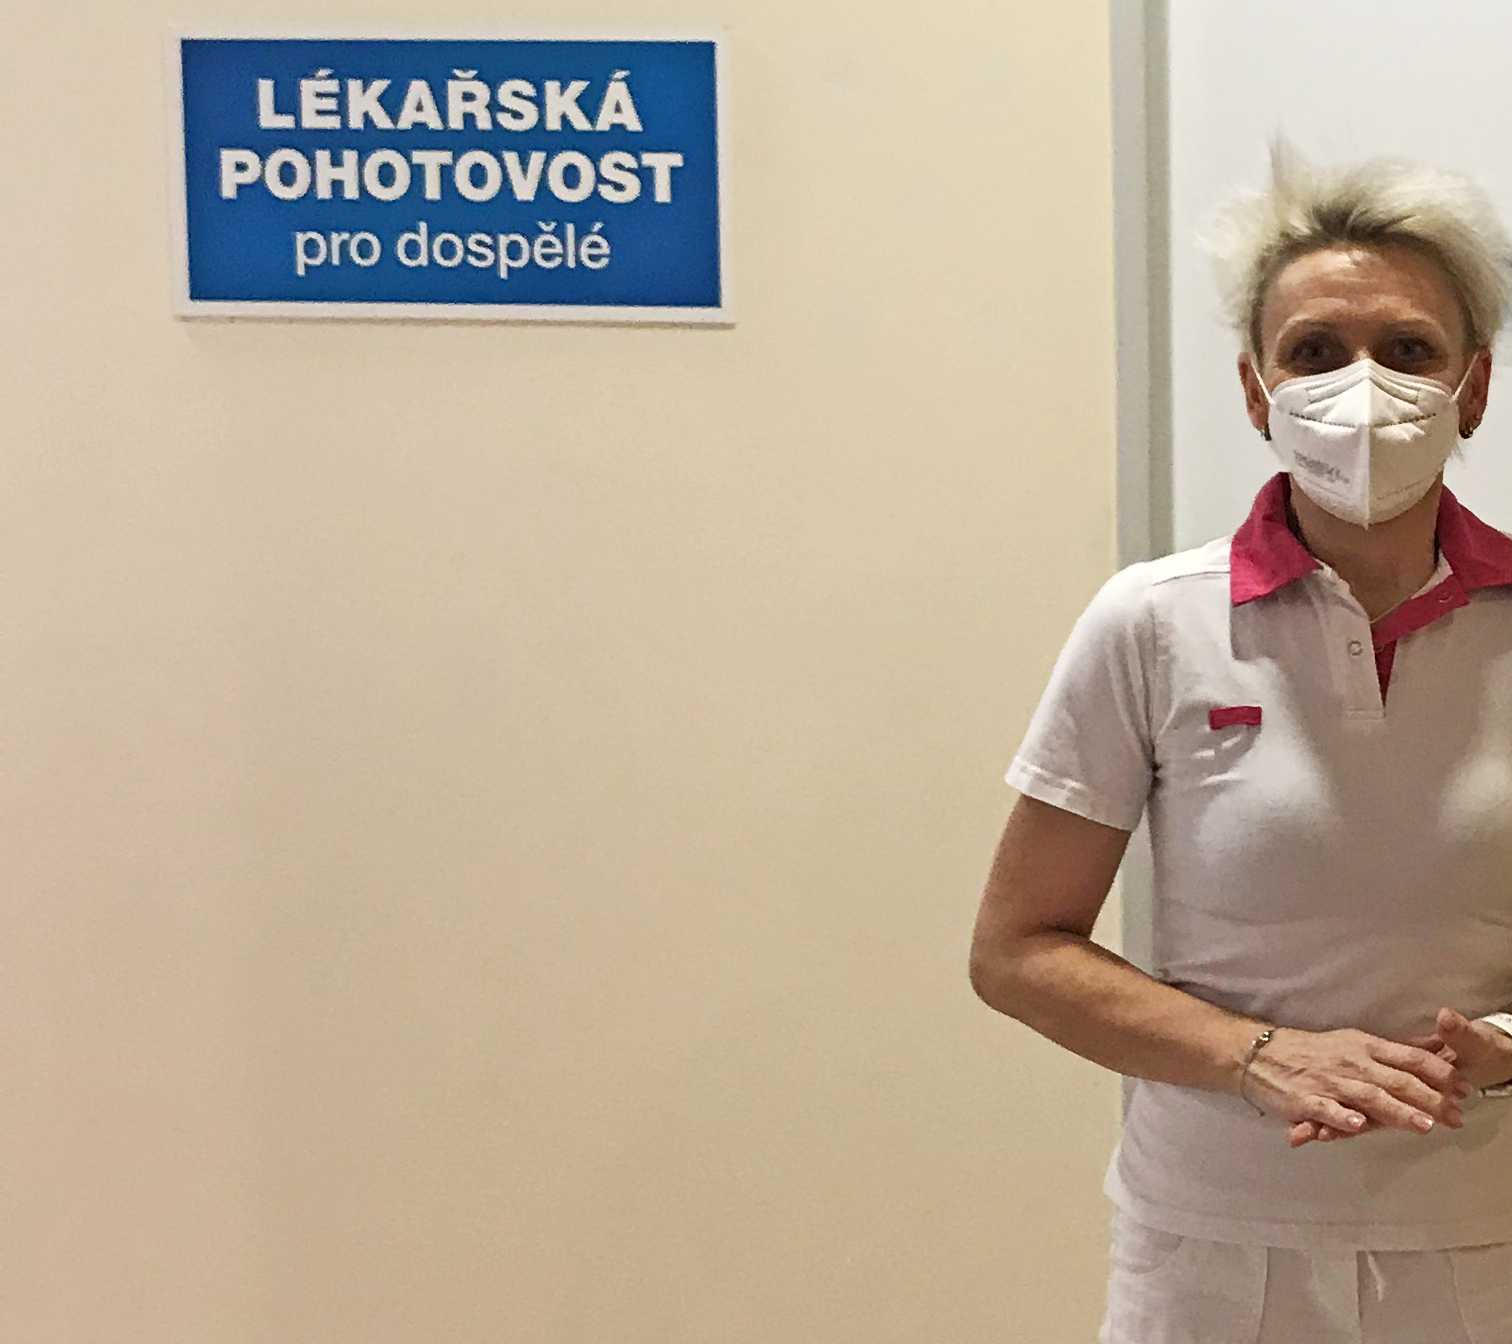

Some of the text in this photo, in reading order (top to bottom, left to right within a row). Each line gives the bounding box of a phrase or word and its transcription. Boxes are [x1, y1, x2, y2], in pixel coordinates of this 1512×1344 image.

[256, 68, 644, 132] LÉKAŘSKÁ
[219, 147, 685, 204] POHOTOVOST
[294, 220, 612, 280] pro dospělé
